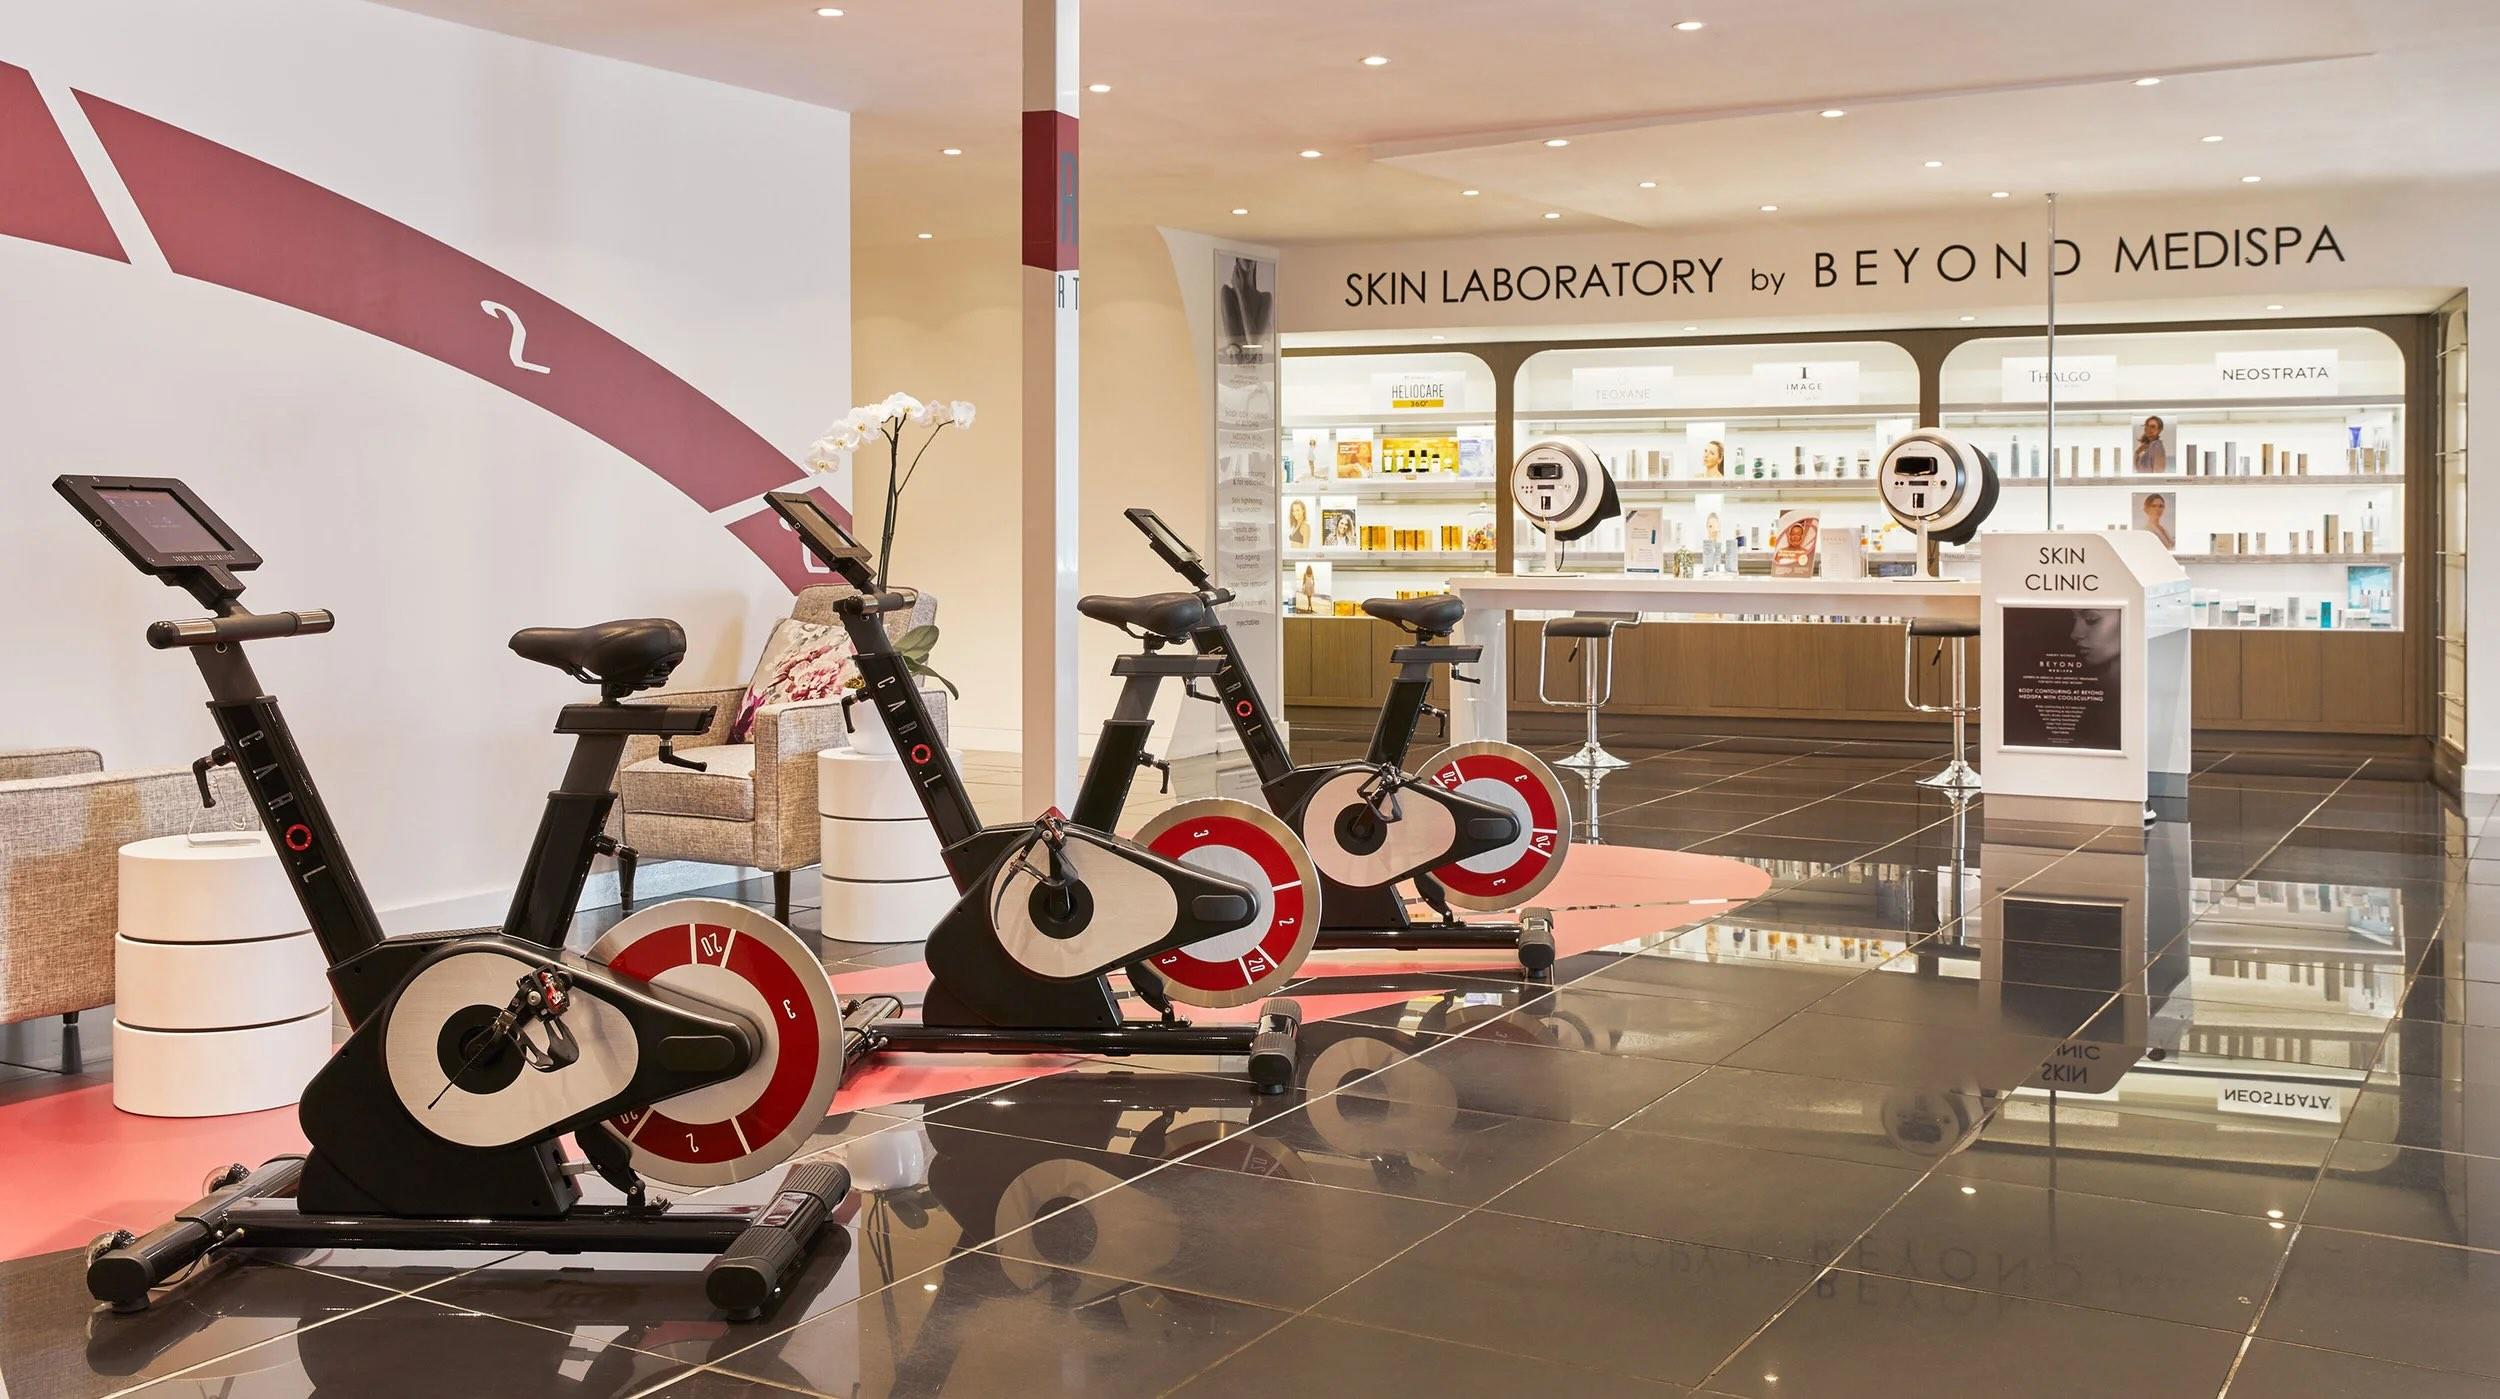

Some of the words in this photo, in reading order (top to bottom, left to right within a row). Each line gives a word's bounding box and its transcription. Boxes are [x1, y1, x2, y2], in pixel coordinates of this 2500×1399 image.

[1344, 270, 1426, 307] SKIN
[1442, 257, 1724, 303] LABORATORY
[1751, 268, 1786, 295] by
[1814, 239, 2081, 289] BEYOND
[2114, 224, 2346, 274] MEDISPA
[481, 299, 550, 374] 2
[2222, 366, 2330, 381] NEOSTRATA
[1391, 383, 1445, 399] HELIOCARE
[1786, 383, 1823, 392] IMAGE
[2039, 546, 2085, 565] SKIN
[2025, 573, 2099, 592] CLINIC
[1193, 829, 1209, 838] 3
[1535, 835, 1551, 848] 20
[1279, 917, 1295, 927] 2
[700, 932, 724, 958] 20
[1162, 955, 1177, 965] 3
[1248, 957, 1266, 973] 20
[783, 999, 797, 1020] 3
[685, 1132, 699, 1154] 2
